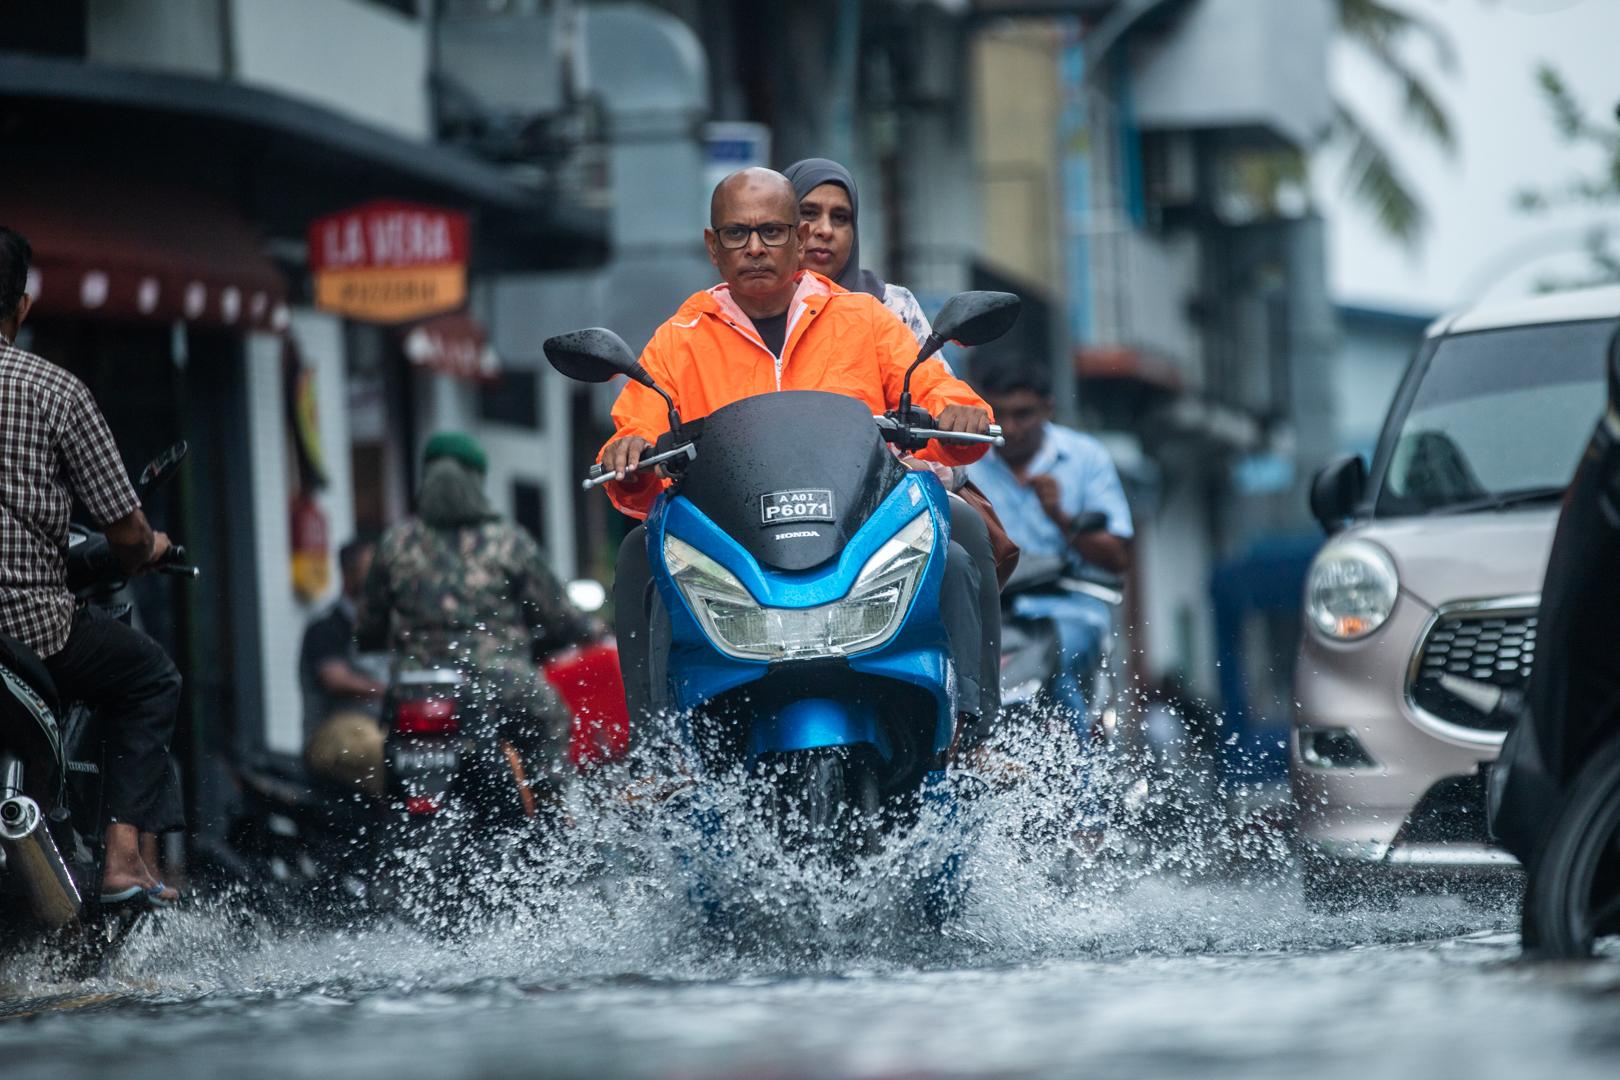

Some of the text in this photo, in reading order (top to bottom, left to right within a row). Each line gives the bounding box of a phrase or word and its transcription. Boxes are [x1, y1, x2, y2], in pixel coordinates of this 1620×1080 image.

[323, 212, 452, 268] LA VERA
[779, 495, 789, 503] A
[766, 503, 828, 519] P6071
[775, 531, 820, 541] HONDA
